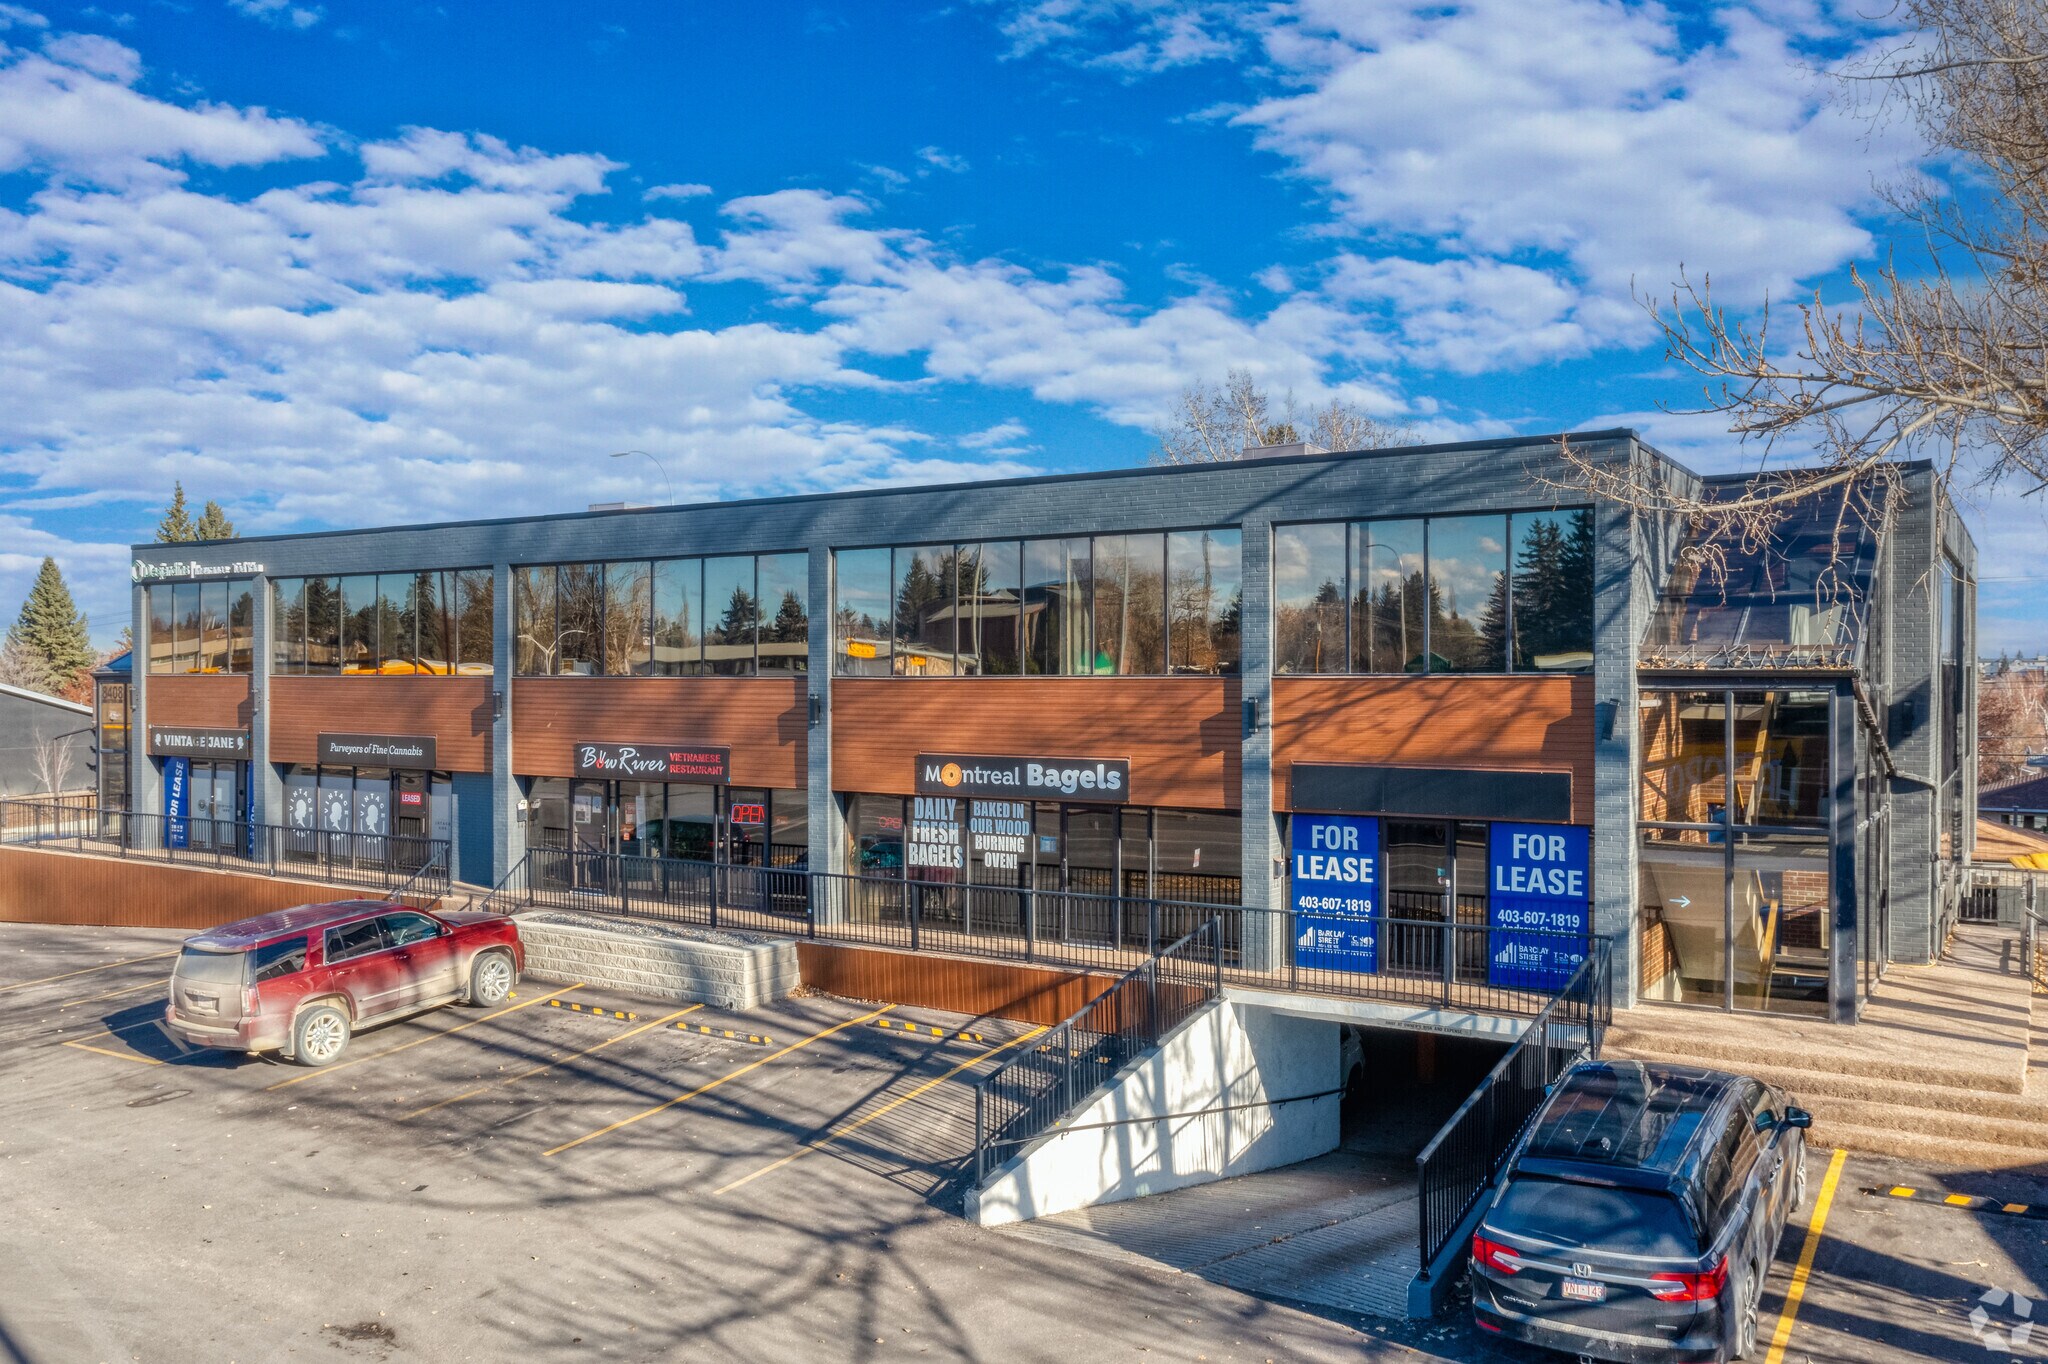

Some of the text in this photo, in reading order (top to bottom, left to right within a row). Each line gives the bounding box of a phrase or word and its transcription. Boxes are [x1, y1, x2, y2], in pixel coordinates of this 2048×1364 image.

[102, 686, 123, 699] 8408
[164, 734, 234, 748] VINTAGE JANE
[330, 743, 423, 756] Purveyors of Fine Cannabis
[619, 747, 667, 774] River
[669, 752, 721, 764] VIETNAMESE
[172, 761, 184, 798] LEASE
[669, 764, 723, 776] RESTAURANT
[925, 763, 1122, 793] Montreal Bagels
[401, 794, 421, 803] LEASED
[914, 797, 957, 821] DAILY
[973, 801, 1025, 819] BAKED IN
[912, 821, 959, 844] FRESH
[970, 818, 1030, 836] OUR WOOD
[975, 834, 1025, 853] BURNING
[1312, 825, 1358, 850] FOR
[908, 843, 964, 869] BAGELS
[1513, 833, 1566, 862] FOR
[984, 852, 1018, 870] OVEN!
[1297, 855, 1374, 883] LEASE
[1496, 865, 1583, 896] LEASE
[1299, 896, 1371, 912] 403-607-1819
[1497, 909, 1580, 928] 403-607-1819
[1519, 945, 1549, 954] BARCAY
